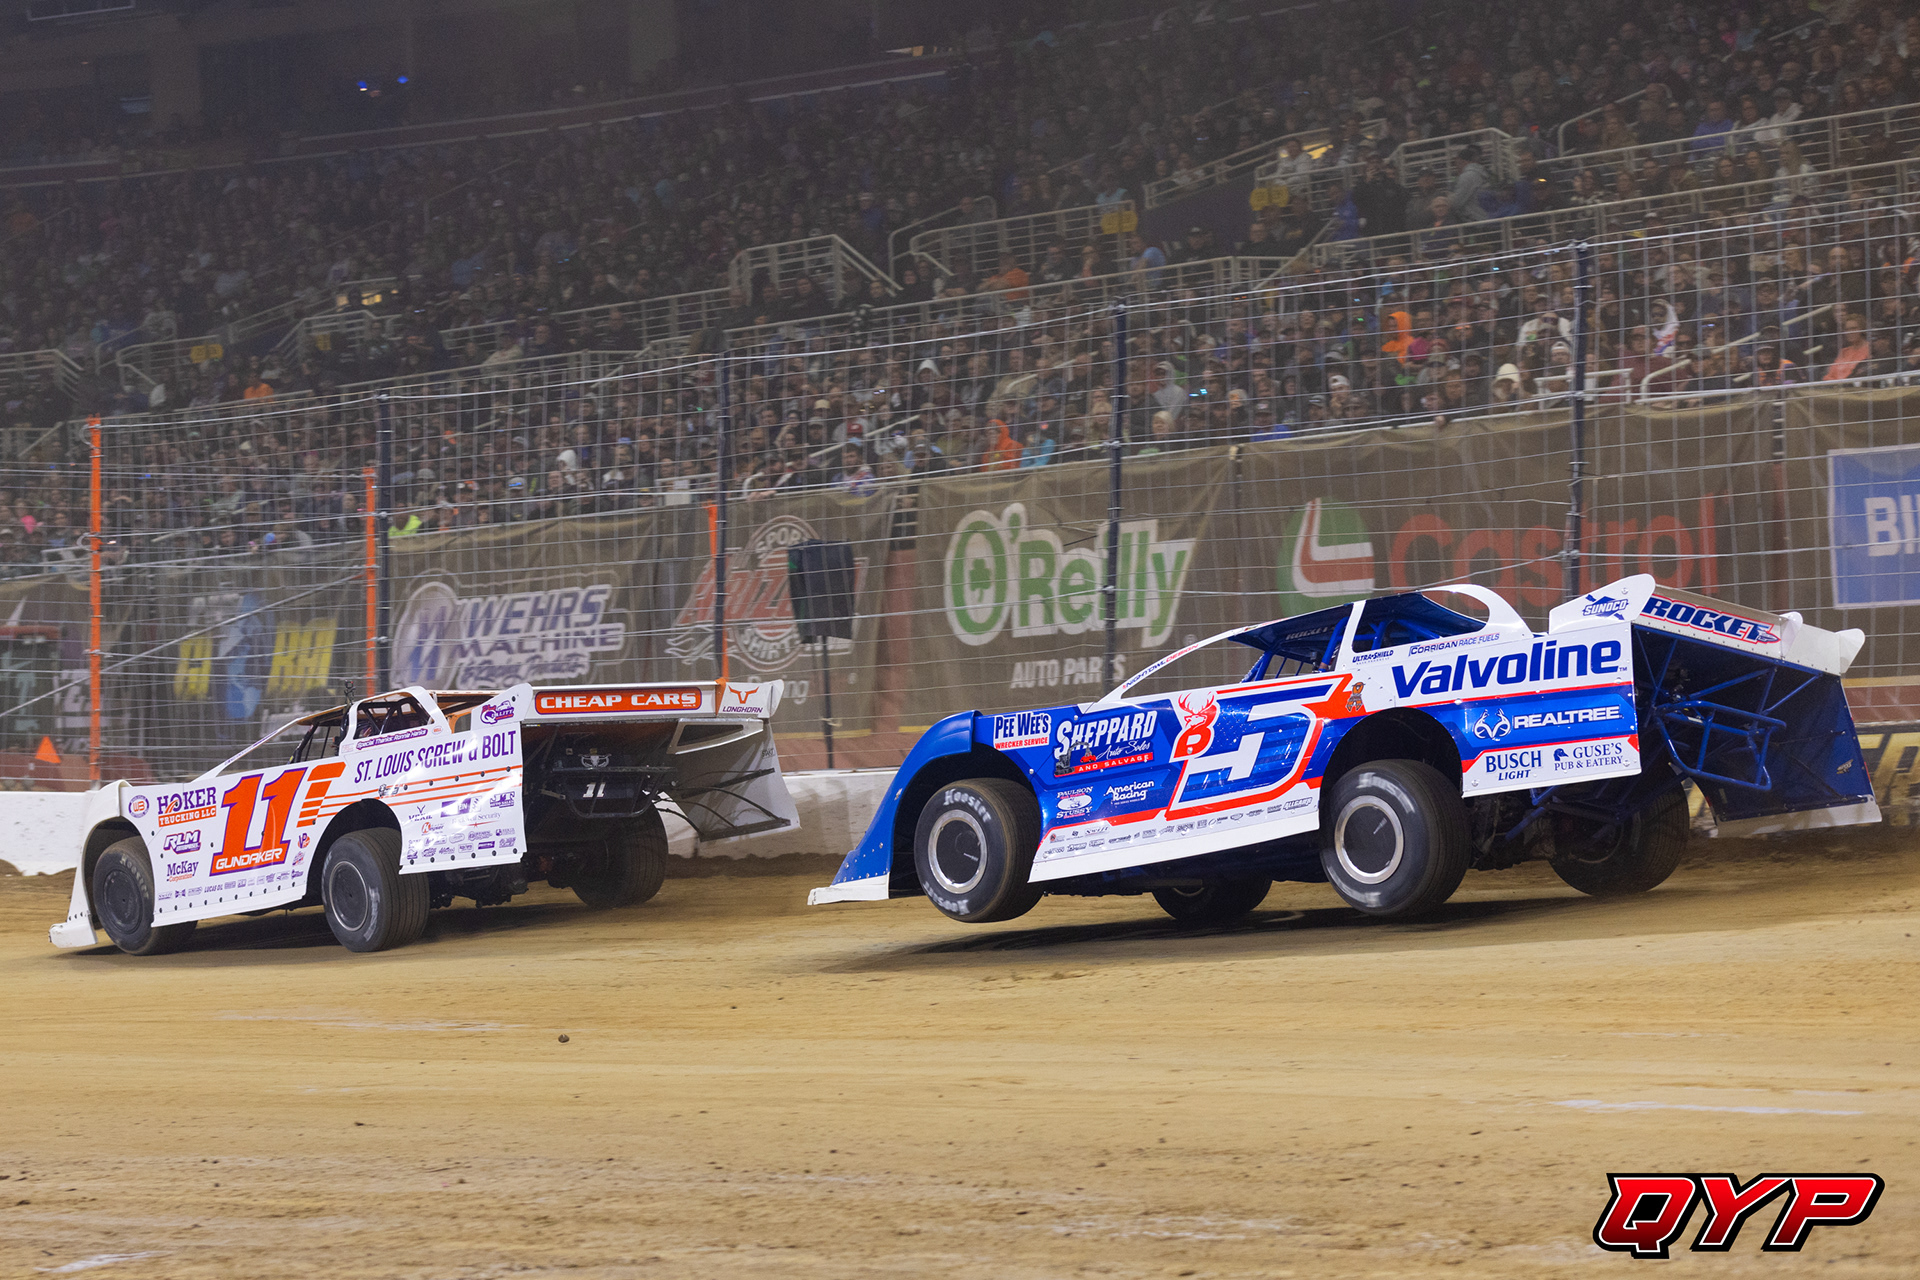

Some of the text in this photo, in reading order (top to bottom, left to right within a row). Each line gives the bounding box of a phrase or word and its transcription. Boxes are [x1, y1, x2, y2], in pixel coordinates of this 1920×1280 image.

[467, 587, 609, 639] WEHRS
[1584, 600, 1628, 616] SUNOCO
[1642, 596, 1774, 644] ROCKET
[453, 627, 623, 659] MACHINE
[1411, 633, 1500, 655] CORRIGAN RACE FUELS
[1010, 654, 1126, 689] AUTO PARS
[1391, 639, 1621, 699] Valvoline
[541, 692, 697, 709] CHEAP CARS
[995, 712, 1050, 740] PEE WEE'S
[1513, 705, 1622, 730] REALTREE
[995, 737, 1049, 750] WRECKER SERVICE
[1054, 710, 1158, 760] SHEPPARD
[354, 760, 373, 784] ST.
[375, 750, 414, 779] LOUIS
[416, 740, 466, 769] SCREW
[482, 731, 517, 760] BOLT
[1573, 742, 1623, 760] GUSE'S
[1078, 754, 1150, 772] AND SALVAGE
[1485, 750, 1543, 774] BUSCH
[1554, 755, 1624, 772] PUB & EATERY
[1498, 769, 1532, 782] LIGHT
[583, 782, 606, 798] 11
[1056, 786, 1094, 799] PAULSON
[1105, 780, 1155, 797] American
[1112, 789, 1148, 803] Racing
[157, 787, 217, 815] HOKER
[159, 807, 217, 827] TRUCKING LLC
[209, 767, 309, 877] 11
[1056, 806, 1093, 819] STUSSY
[164, 830, 200, 851] RLM
[167, 860, 199, 877] McKay
[215, 848, 284, 871] GUNDAKER
